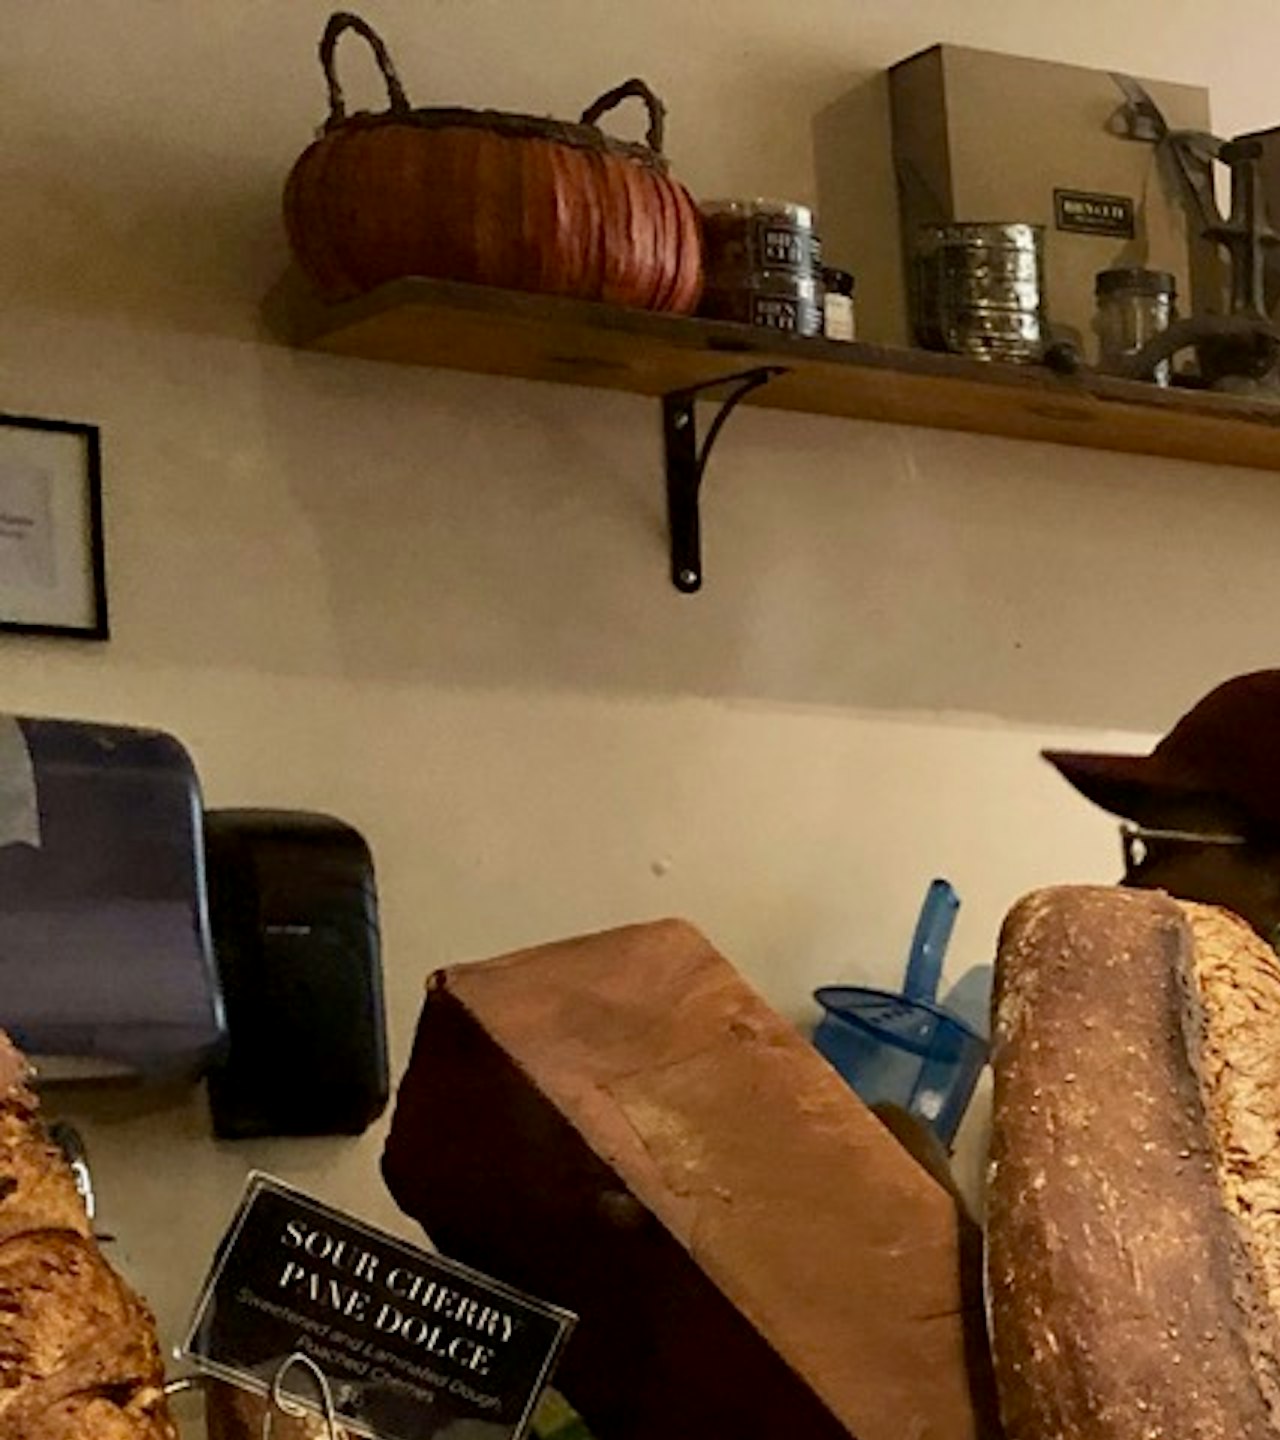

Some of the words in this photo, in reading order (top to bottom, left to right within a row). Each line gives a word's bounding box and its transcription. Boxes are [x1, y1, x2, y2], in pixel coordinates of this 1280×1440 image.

[278, 1260, 367, 1323] PANE
[374, 1302, 498, 1376] DOLCE
[281, 1219, 380, 1284] SOUR
[385, 1267, 518, 1343] CHERRY
